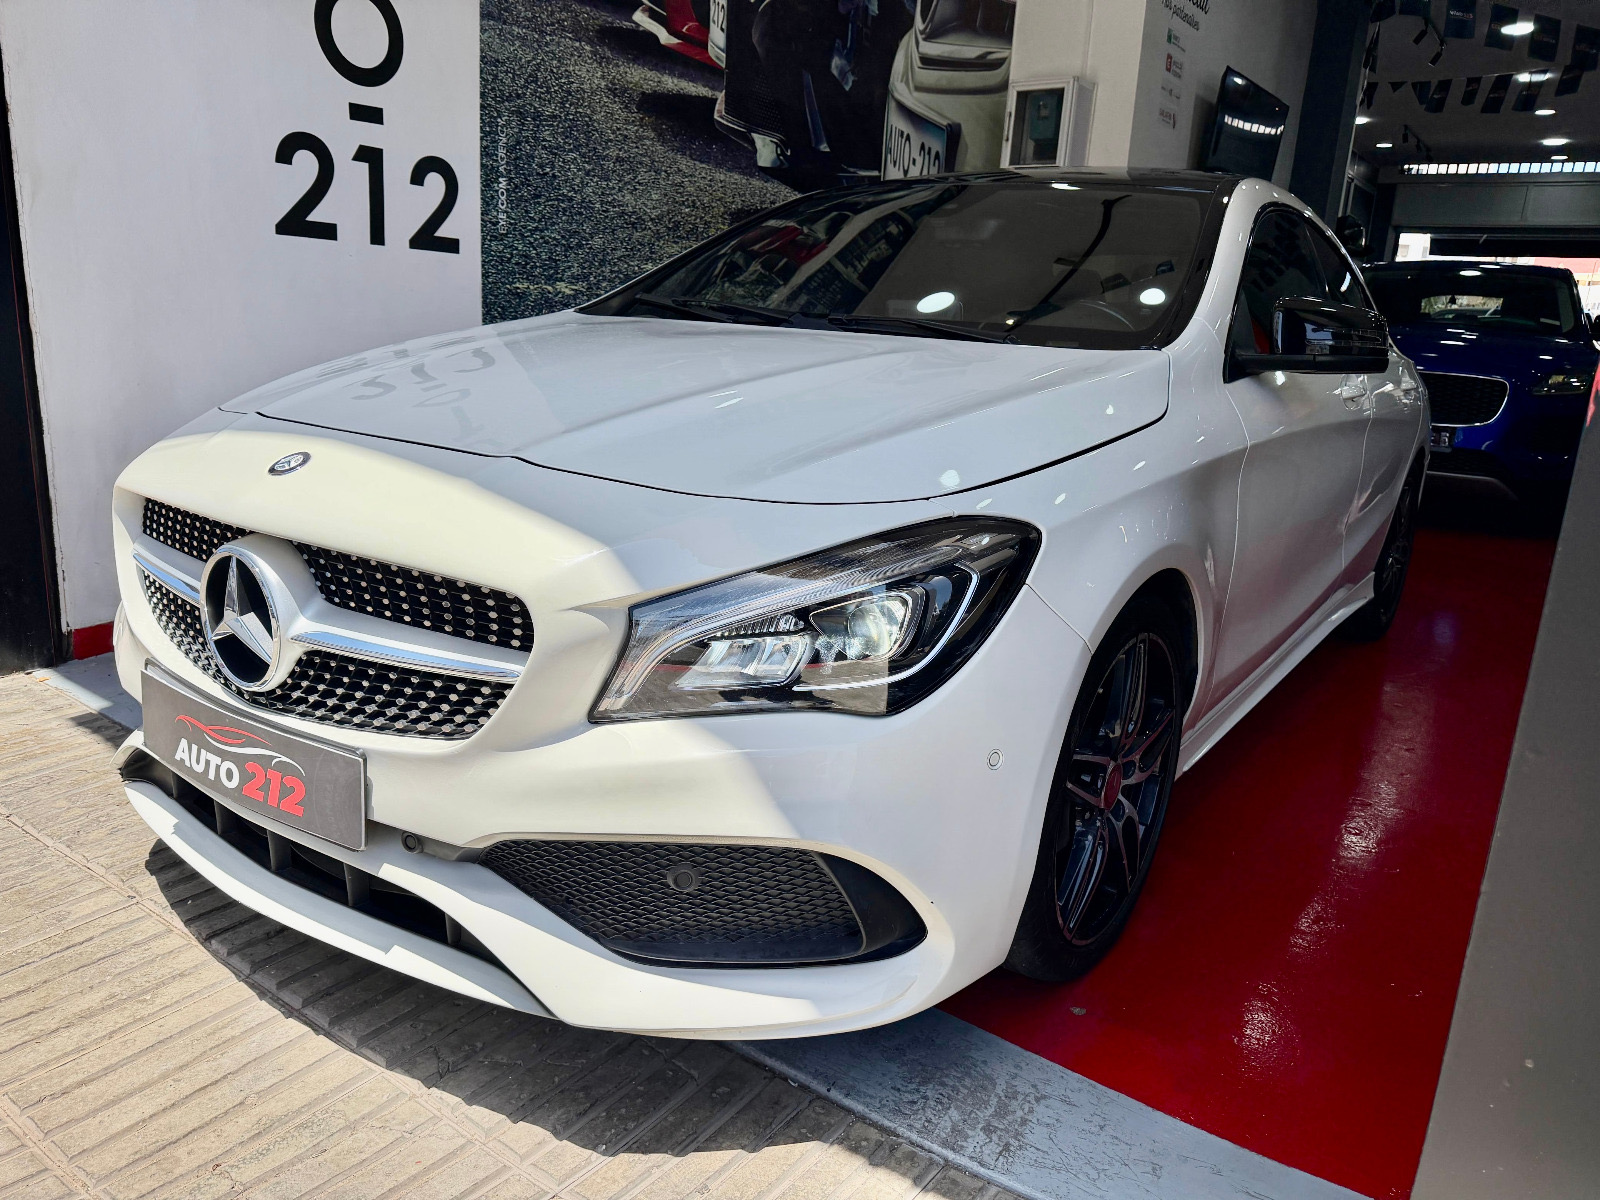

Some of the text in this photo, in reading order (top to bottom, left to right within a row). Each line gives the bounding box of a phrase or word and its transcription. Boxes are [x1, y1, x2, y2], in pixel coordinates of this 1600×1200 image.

[498, 118, 507, 174] AGENCY
[275, 131, 460, 254] 212
[174, 738, 306, 817] AUTO 212
